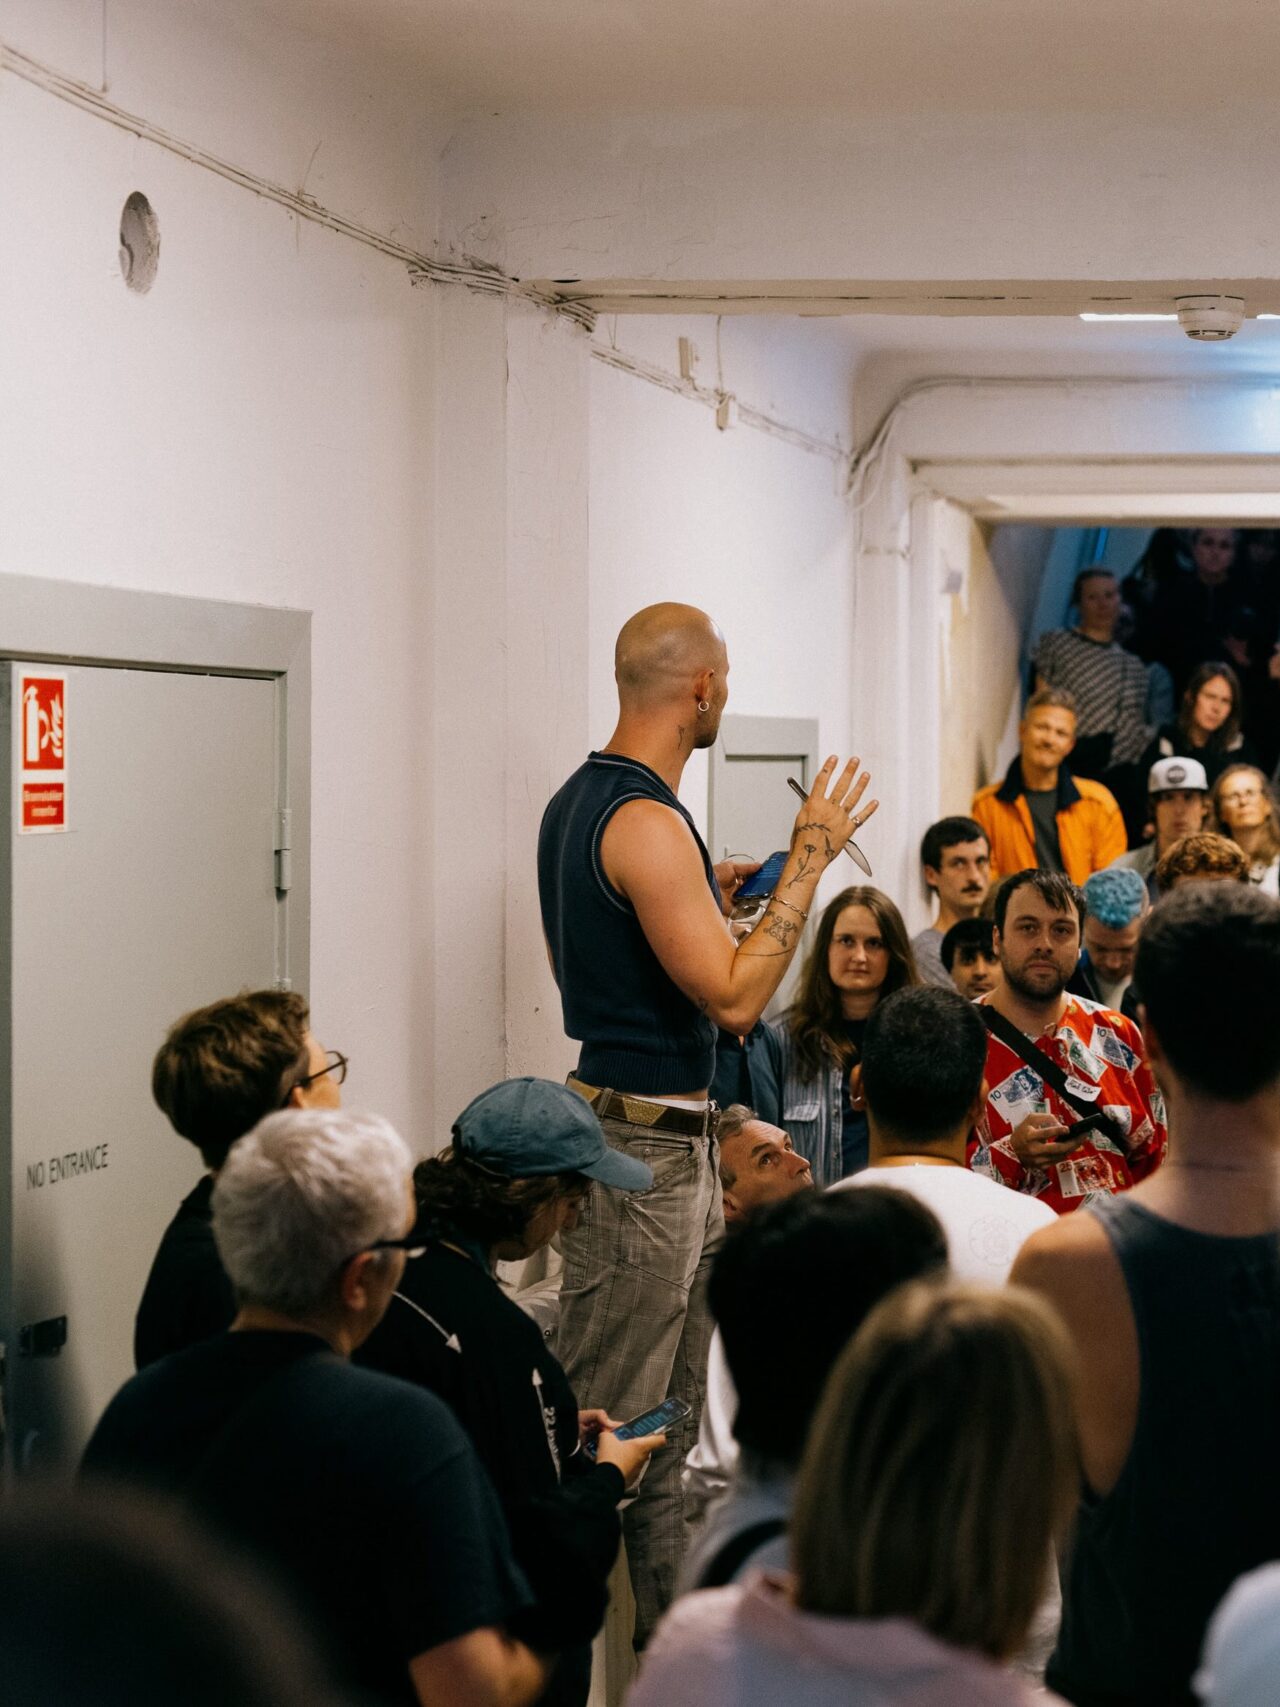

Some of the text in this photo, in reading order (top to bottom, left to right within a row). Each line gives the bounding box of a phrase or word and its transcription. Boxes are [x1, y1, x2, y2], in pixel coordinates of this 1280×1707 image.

[1097, 1027, 1107, 1038] 10
[990, 1089, 1002, 1101] 10
[27, 1143, 108, 1190] NO ENTRANCE
